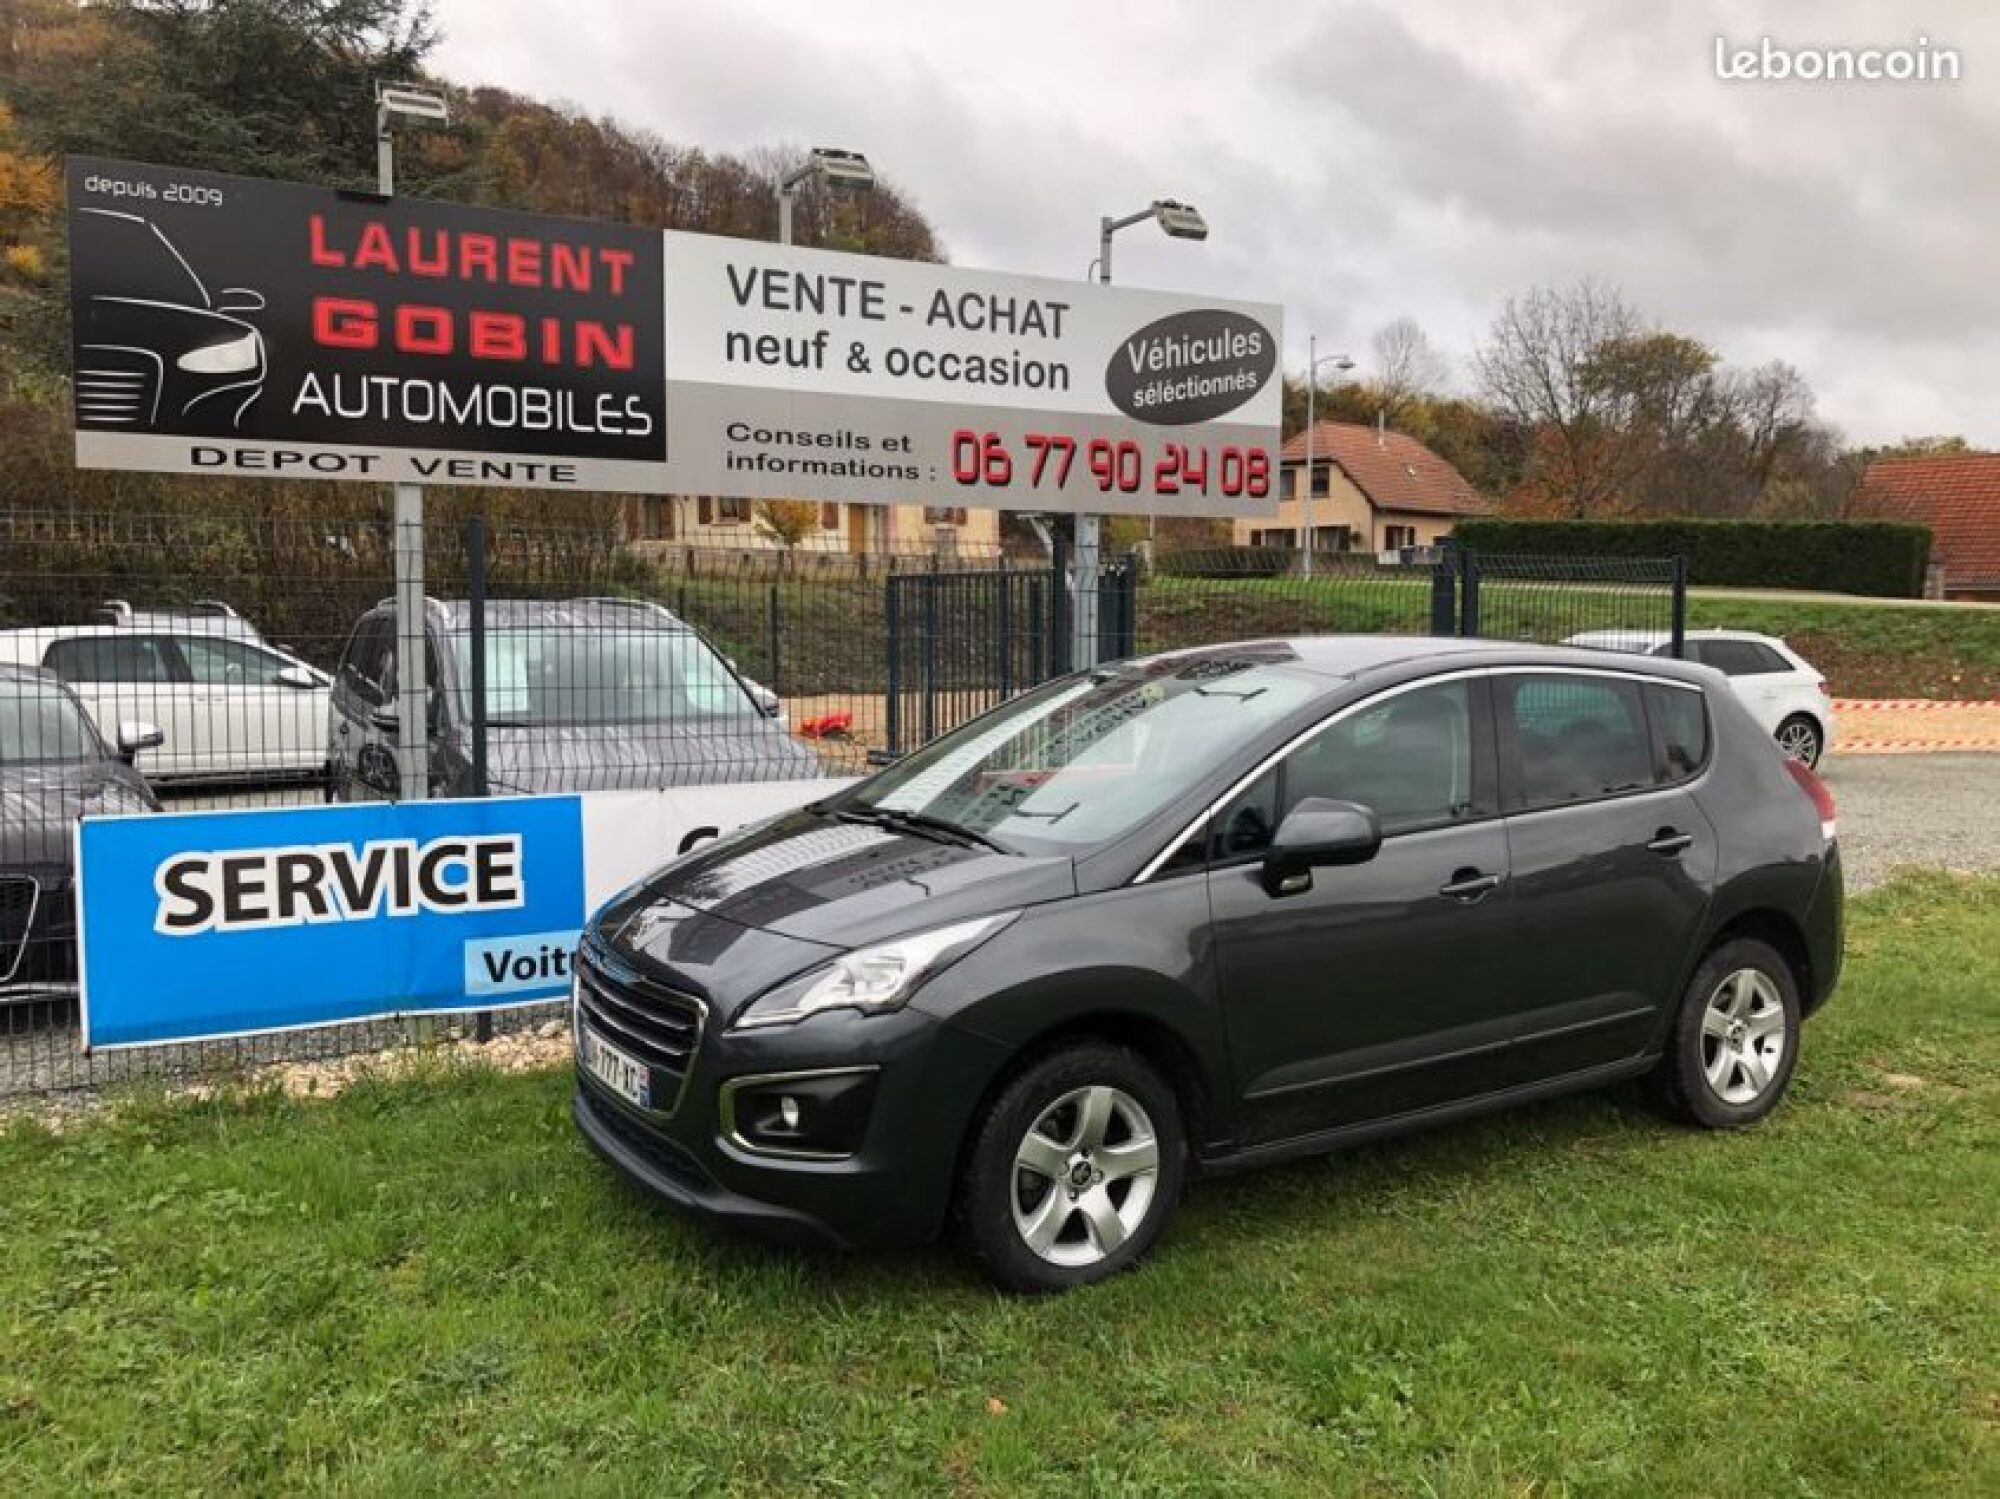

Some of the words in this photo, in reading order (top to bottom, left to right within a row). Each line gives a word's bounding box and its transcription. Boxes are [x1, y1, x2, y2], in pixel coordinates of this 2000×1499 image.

[84, 174, 157, 199] depuis
[162, 183, 223, 206] 2009
[308, 214, 636, 296] LAURENT
[726, 263, 887, 321] VENTE
[926, 289, 1070, 340] ACHAT
[312, 296, 636, 371] GOBIN
[726, 330, 830, 369] neuf
[847, 341, 872, 374] &
[885, 343, 1070, 390] occasion
[1128, 327, 1262, 374] Véhicules
[293, 371, 653, 436] AUTOMOBILES
[190, 445, 380, 476] DEPOT
[409, 456, 577, 483] VENTE
[726, 422, 871, 450] Conseils
[881, 433, 913, 453] et
[726, 450, 920, 480] informations
[952, 430, 1012, 487] 06
[1024, 433, 1077, 490] 77
[1088, 438, 1141, 493] 90
[1154, 442, 1207, 496] 24
[1221, 445, 1269, 498] 08
[162, 841, 519, 928] SERVICE
